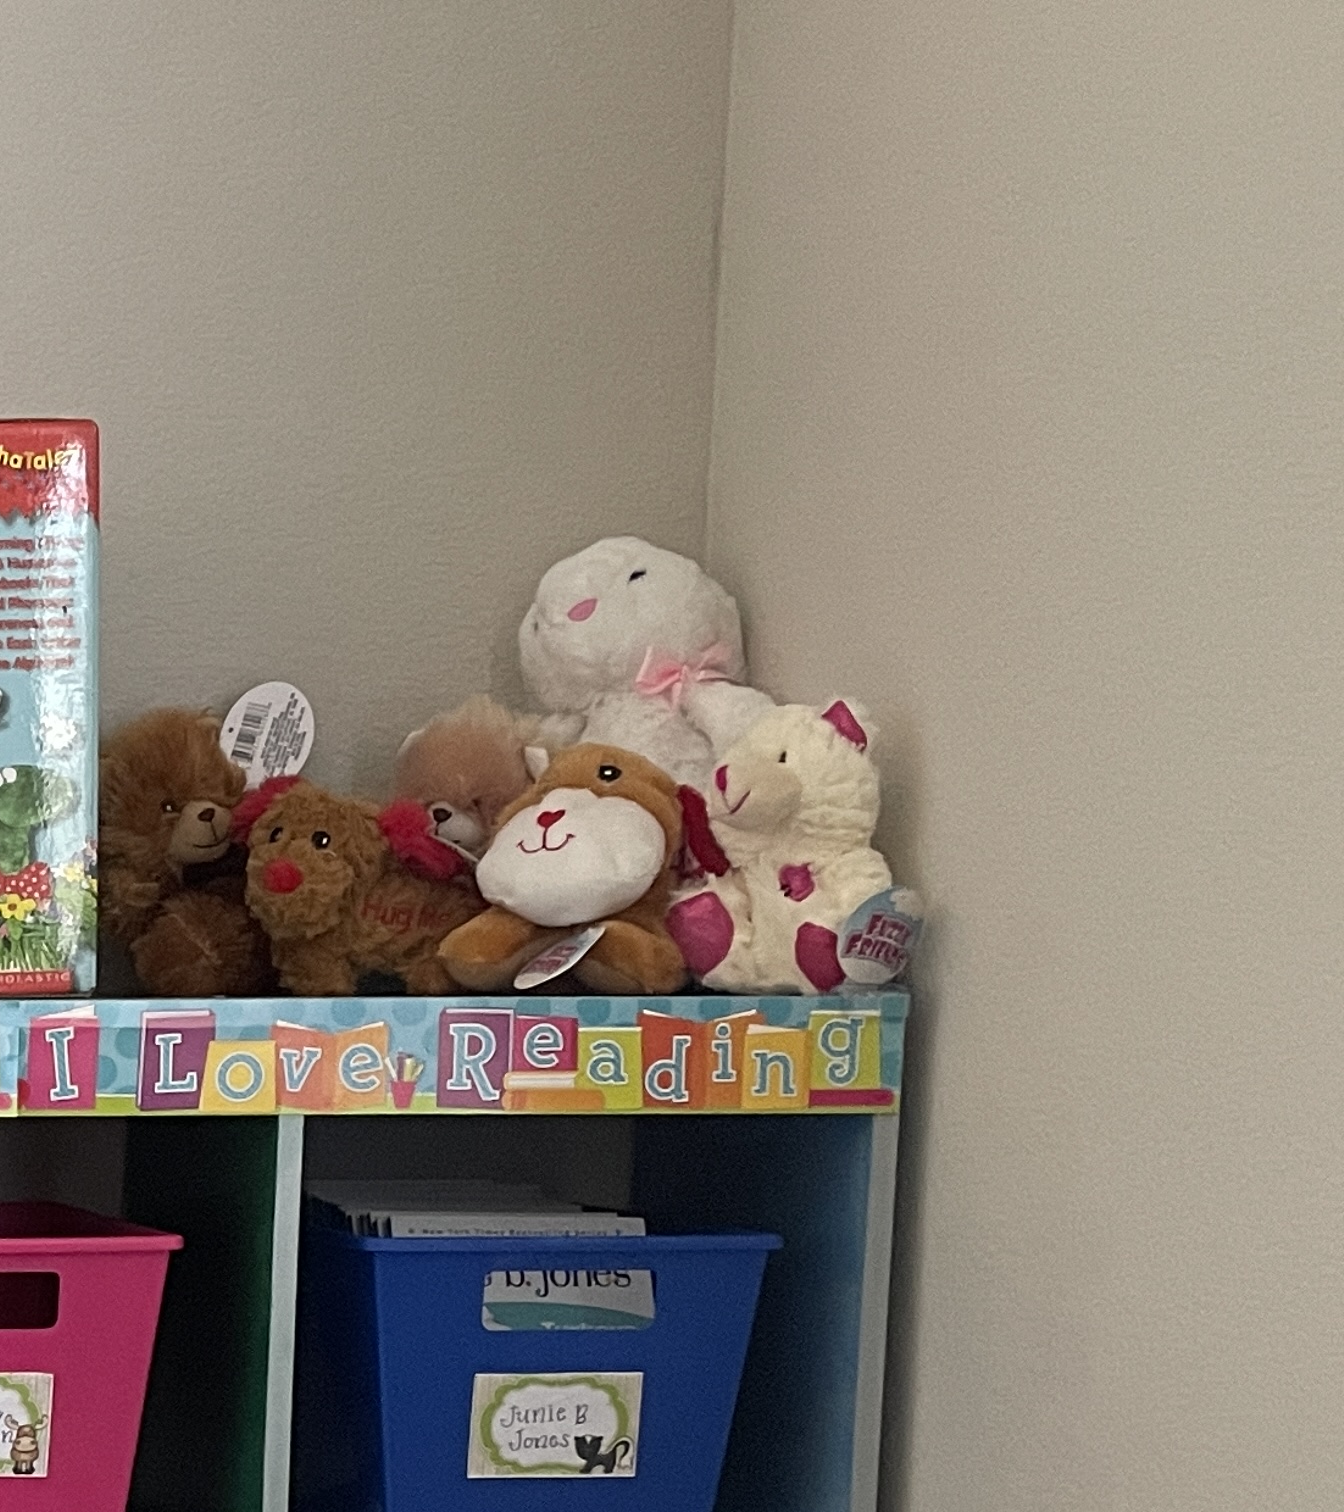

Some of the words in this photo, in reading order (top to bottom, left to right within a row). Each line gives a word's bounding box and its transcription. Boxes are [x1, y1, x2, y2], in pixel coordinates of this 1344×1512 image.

[361, 894, 413, 935] Hug
[44, 1028, 76, 1101] I
[153, 1034, 383, 1101] Love
[446, 1015, 864, 1103] Reading
[499, 1404, 567, 1428] Junie
[574, 1403, 589, 1425] B
[508, 1429, 570, 1451] Jones
